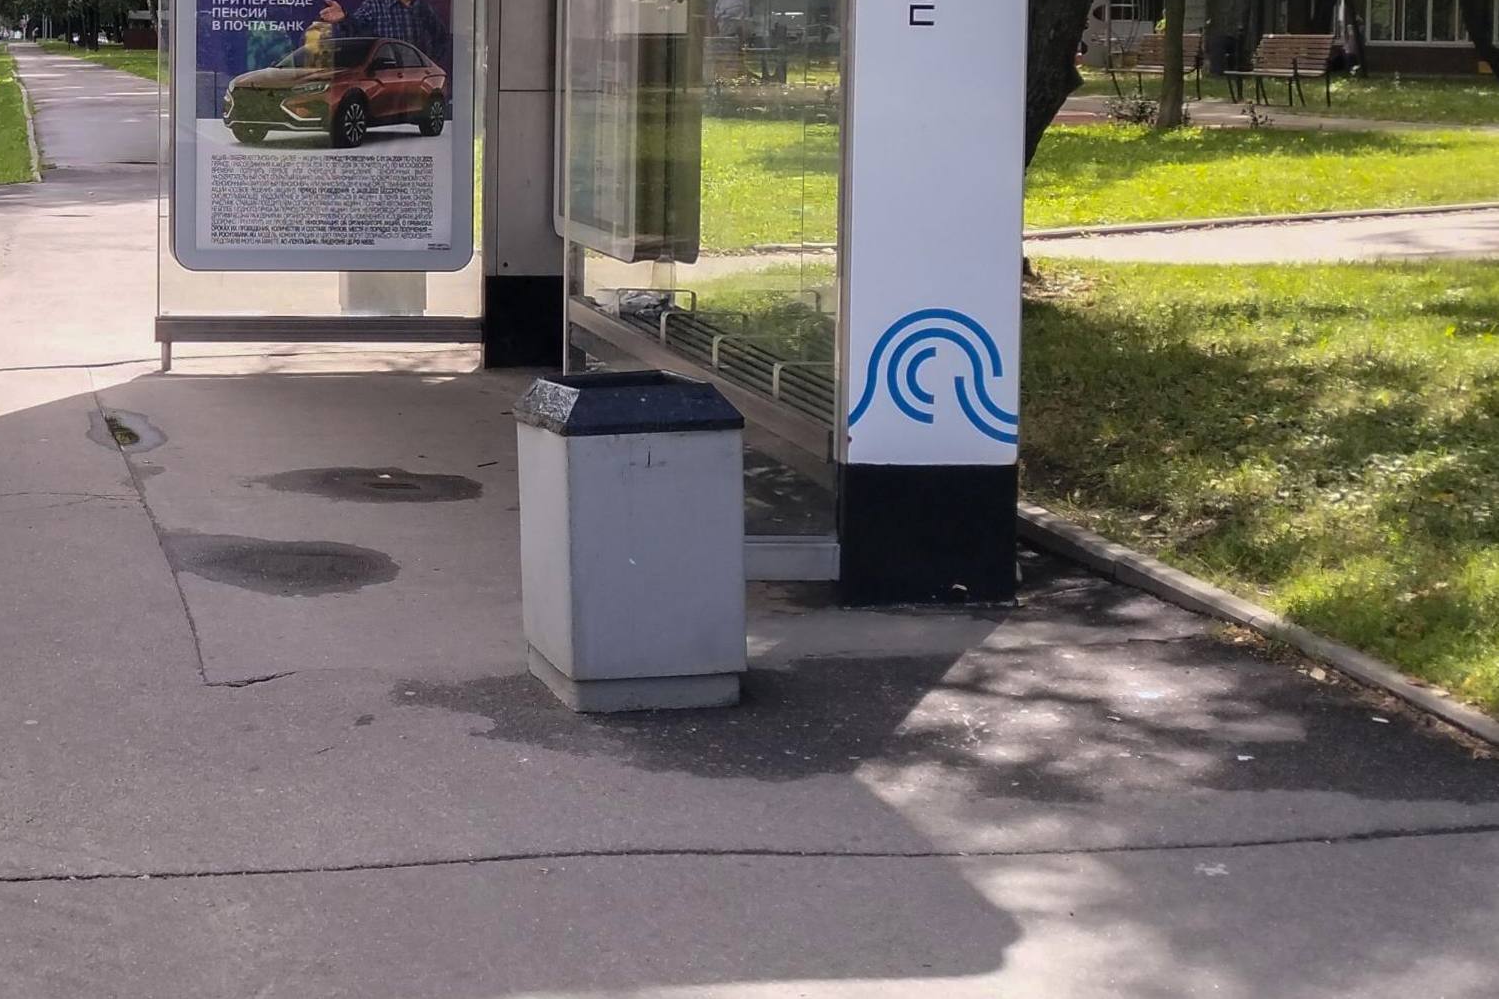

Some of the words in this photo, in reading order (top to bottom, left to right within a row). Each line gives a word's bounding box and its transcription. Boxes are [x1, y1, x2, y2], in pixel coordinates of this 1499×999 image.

[212, 7, 267, 17] ПЕНСИИ
[212, 21, 221, 30] В
[224, 21, 266, 31] ПОЧТА
[269, 21, 304, 31] БАНК
